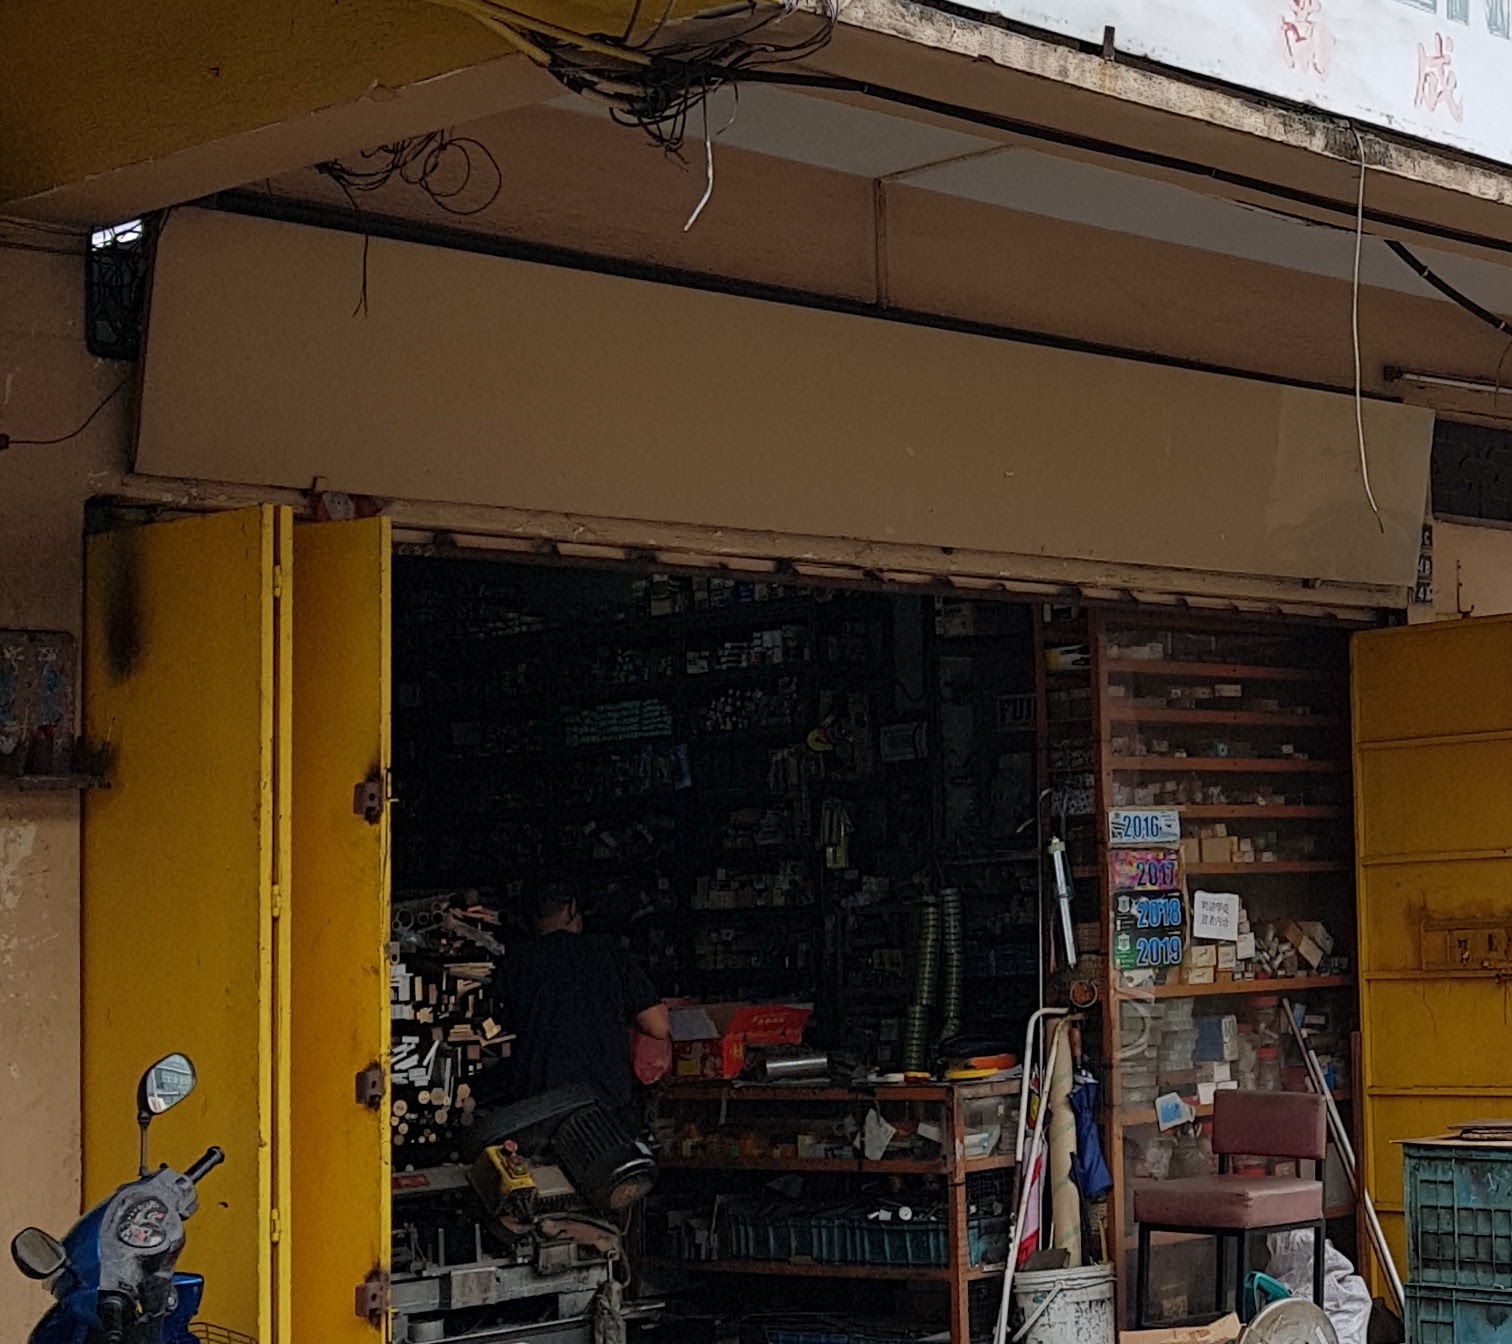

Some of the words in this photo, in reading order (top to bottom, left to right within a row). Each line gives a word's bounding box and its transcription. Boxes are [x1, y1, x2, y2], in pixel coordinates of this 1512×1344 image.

[1122, 815, 1160, 839] 2016
[1136, 861, 1176, 887] 2017
[1137, 898, 1182, 928] 2018
[1136, 936, 1183, 966] 2019
